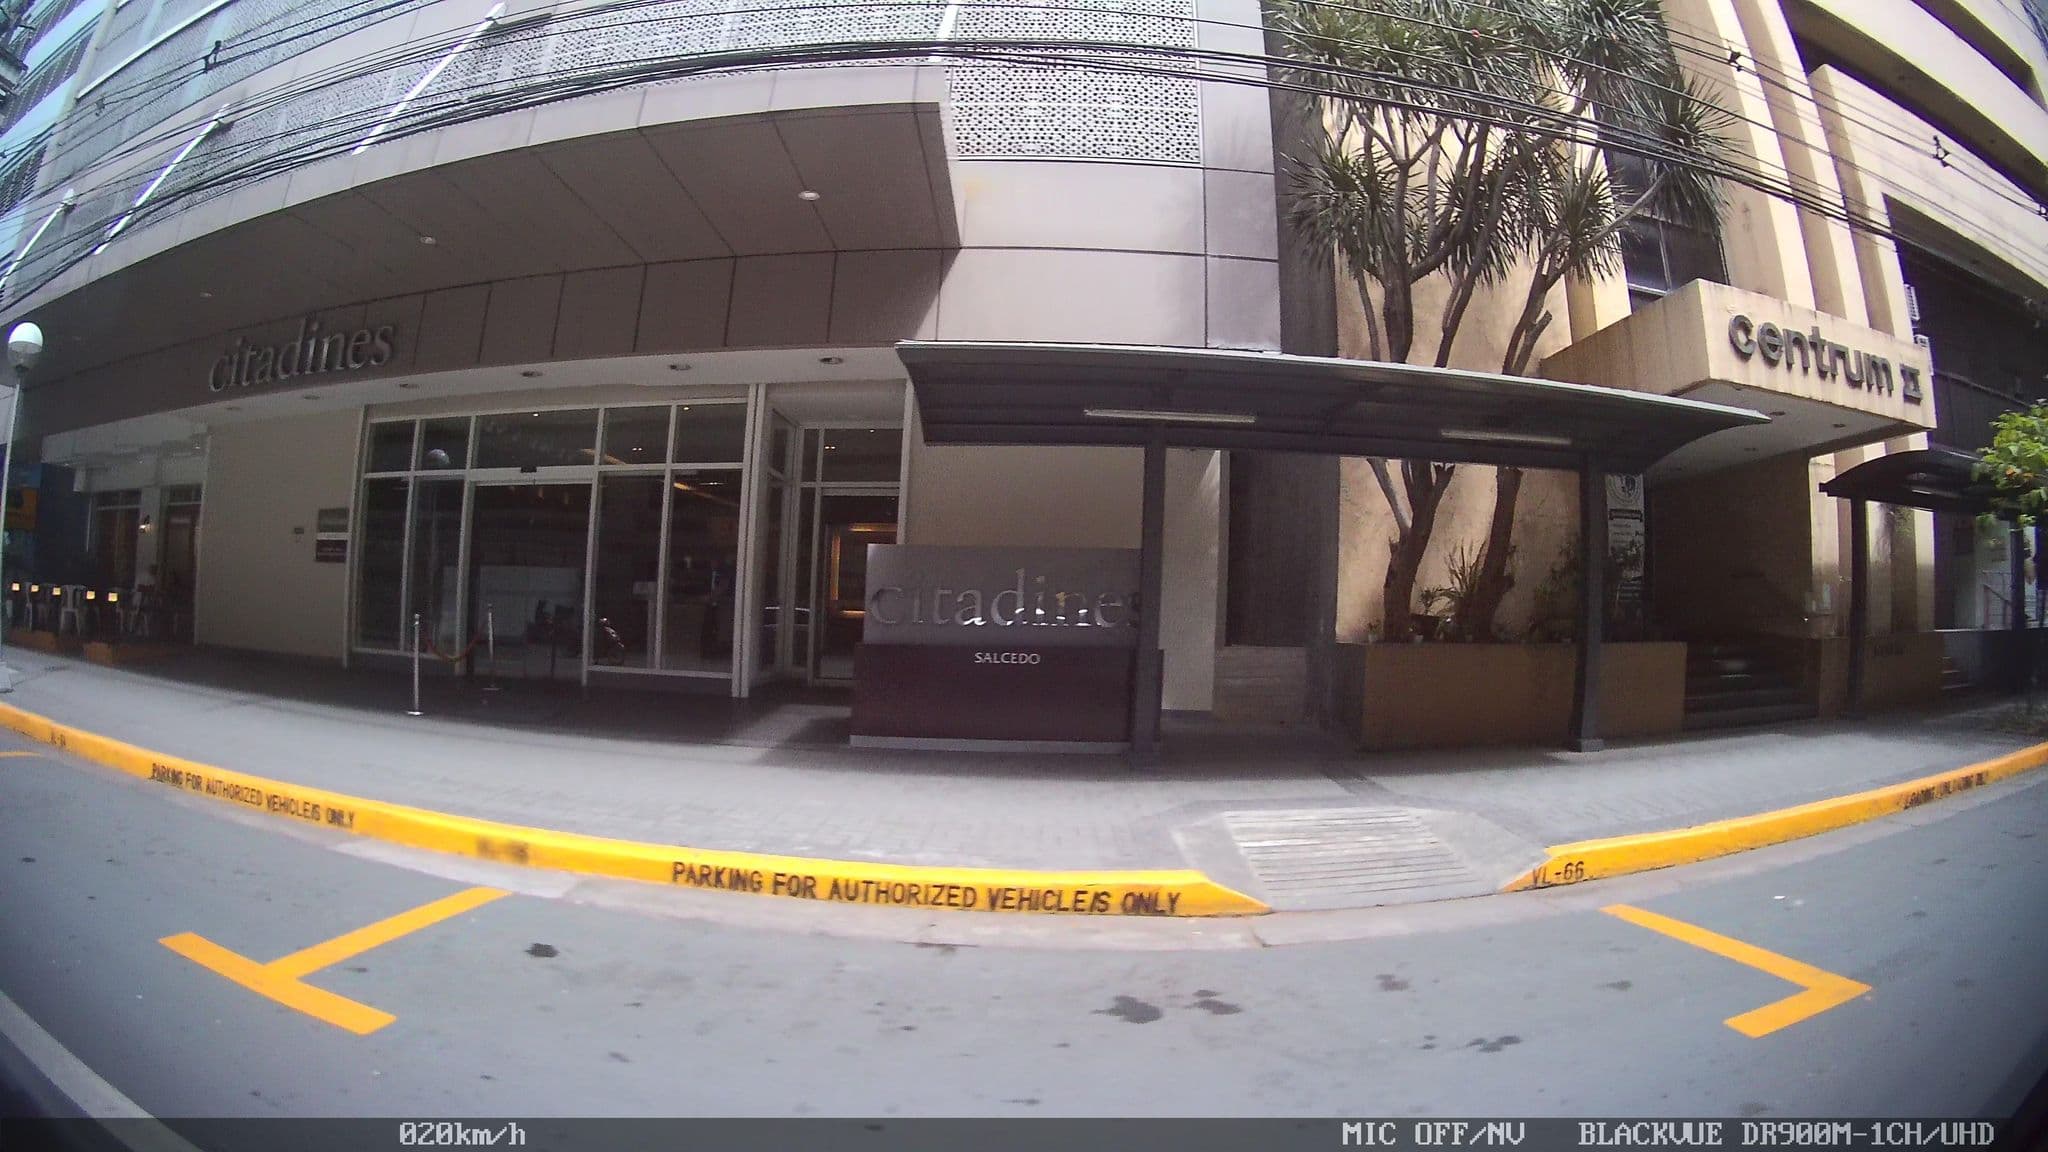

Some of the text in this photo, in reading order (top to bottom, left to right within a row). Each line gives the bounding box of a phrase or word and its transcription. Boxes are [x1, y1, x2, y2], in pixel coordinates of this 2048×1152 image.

[208, 314, 395, 392] citadines
[1729, 315, 1894, 394] centrum
[974, 652, 1041, 665] SALCEDO
[152, 763, 183, 788] PARKING
[186, 772, 202, 792] FOR
[205, 777, 263, 806] AUTHORIZED
[326, 807, 355, 828] ONLY
[672, 861, 763, 893] PARKING
[772, 872, 817, 900] FOR
[829, 877, 977, 908] AUTHORIZED
[1120, 891, 1182, 914] ONLY
[1532, 860, 1584, 887] VL-66
